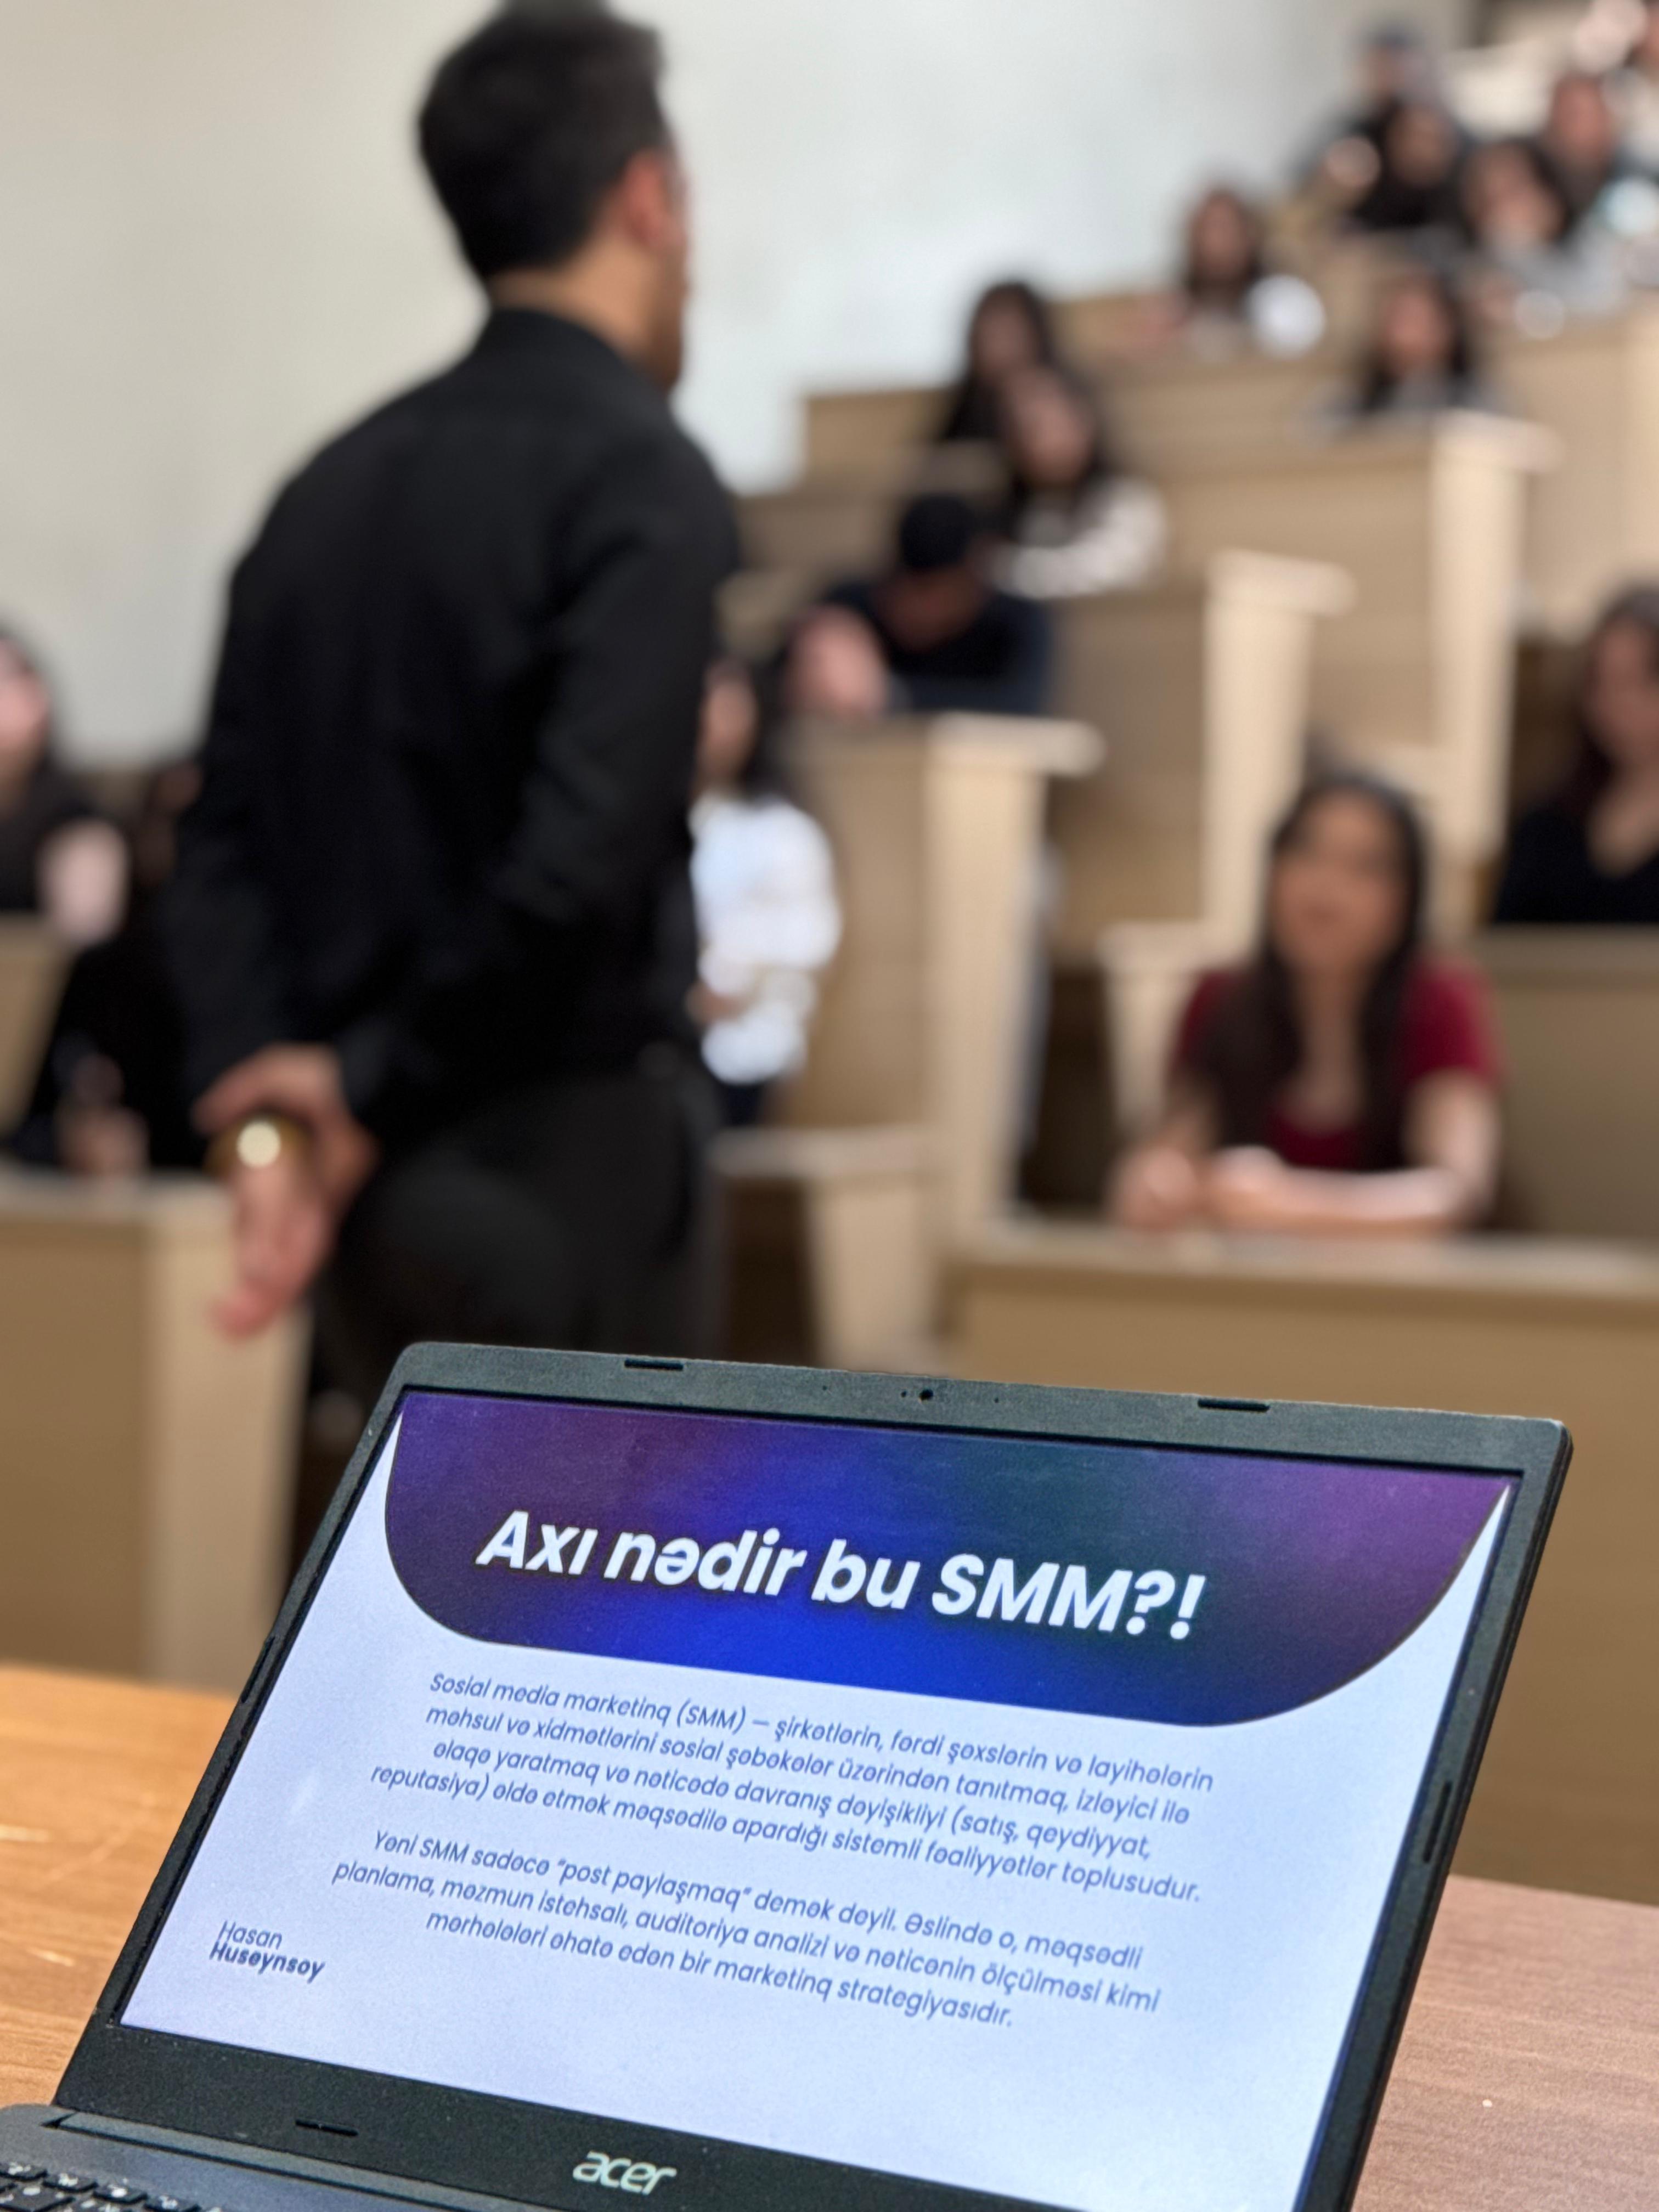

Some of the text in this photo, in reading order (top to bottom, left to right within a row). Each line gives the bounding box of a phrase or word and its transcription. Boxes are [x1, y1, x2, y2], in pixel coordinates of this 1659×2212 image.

[475, 1510, 1206, 1640] Axı nədir bu SMM?!
[425, 1707, 1190, 1824] məhsul və xidmətlərini sosial şəbəkələr üzərindən tanıtmaq, izləyici ilə
[430, 1673, 492, 1698] Sosial
[492, 1684, 560, 1707] media
[563, 1693, 672, 1728] marketinq
[676, 1699, 747, 1735] (SMM)
[775, 1716, 883, 1753] şirkətlərin,
[890, 1729, 946, 1756] fərdi
[947, 1742, 1048, 1770] şəxslərin
[1056, 1755, 1082, 1774] və
[1087, 1754, 1214, 1792] layihələrin
[370, 1766, 1199, 1901] reputasiya) əldə etmək məqsədilə apardığı sistemli fəaliyyətlər toplusudur.
[433, 1739, 1150, 1860] əlaqə yaratmaq və nəticədə davranış dəyişikliyi (satış, qeydiyyat,
[218, 1920, 283, 1950] Hasan
[331, 1860, 1161, 2012] planlama, məzmun istehsalı, auditoriya analizi və nəticənin ölçülməsi kimi
[375, 1830, 419, 1855] Yəni
[419, 1838, 470, 1864] SMM
[471, 1849, 550, 1876] sadəcə
[754, 1889, 834, 1921] demək
[838, 1902, 898, 1934] dəyil.
[904, 1912, 993, 1946] Əslində
[998, 1931, 1017, 1954] o,
[1024, 1935, 1143, 1969] məqsədli
[426, 1912, 1011, 2027] mərhələləri əhatə edən bir marketinq strategiyasıdır.
[572, 2150, 678, 2195] acer
